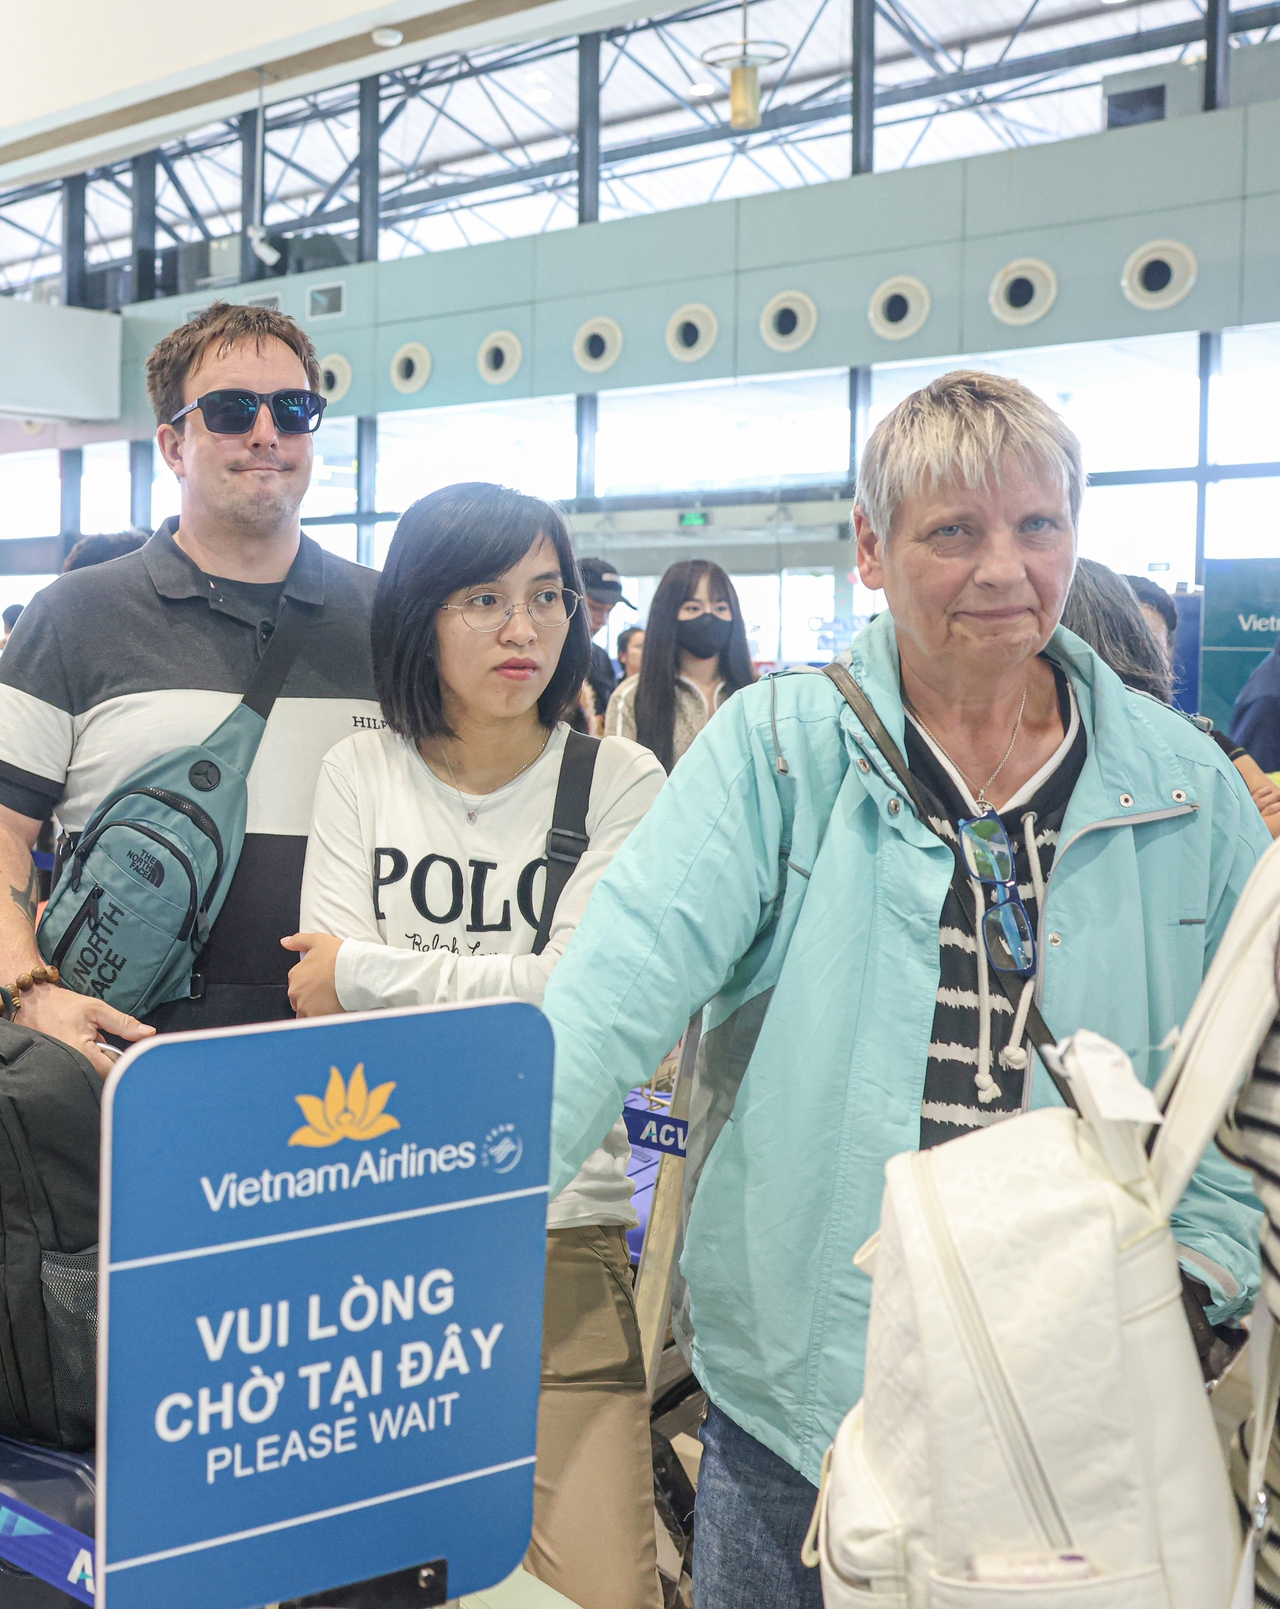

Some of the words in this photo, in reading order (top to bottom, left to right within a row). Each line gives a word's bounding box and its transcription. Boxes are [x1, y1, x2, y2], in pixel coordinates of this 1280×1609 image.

[126, 850, 152, 871] NORTH
[129, 861, 150, 881] FACE
[140, 849, 157, 865] THE
[73, 901, 125, 984] NORTH
[200, 1162, 350, 1212] Vietnam
[351, 1141, 477, 1188] Airlines
[195, 1300, 289, 1362] VUI
[308, 1267, 455, 1341] LÒNG
[155, 1365, 285, 1442] CHỜ
[297, 1350, 383, 1413] TẠI
[396, 1322, 505, 1389] ĐÂY
[206, 1416, 358, 1484] PLEASE
[369, 1391, 460, 1444] WAIT
